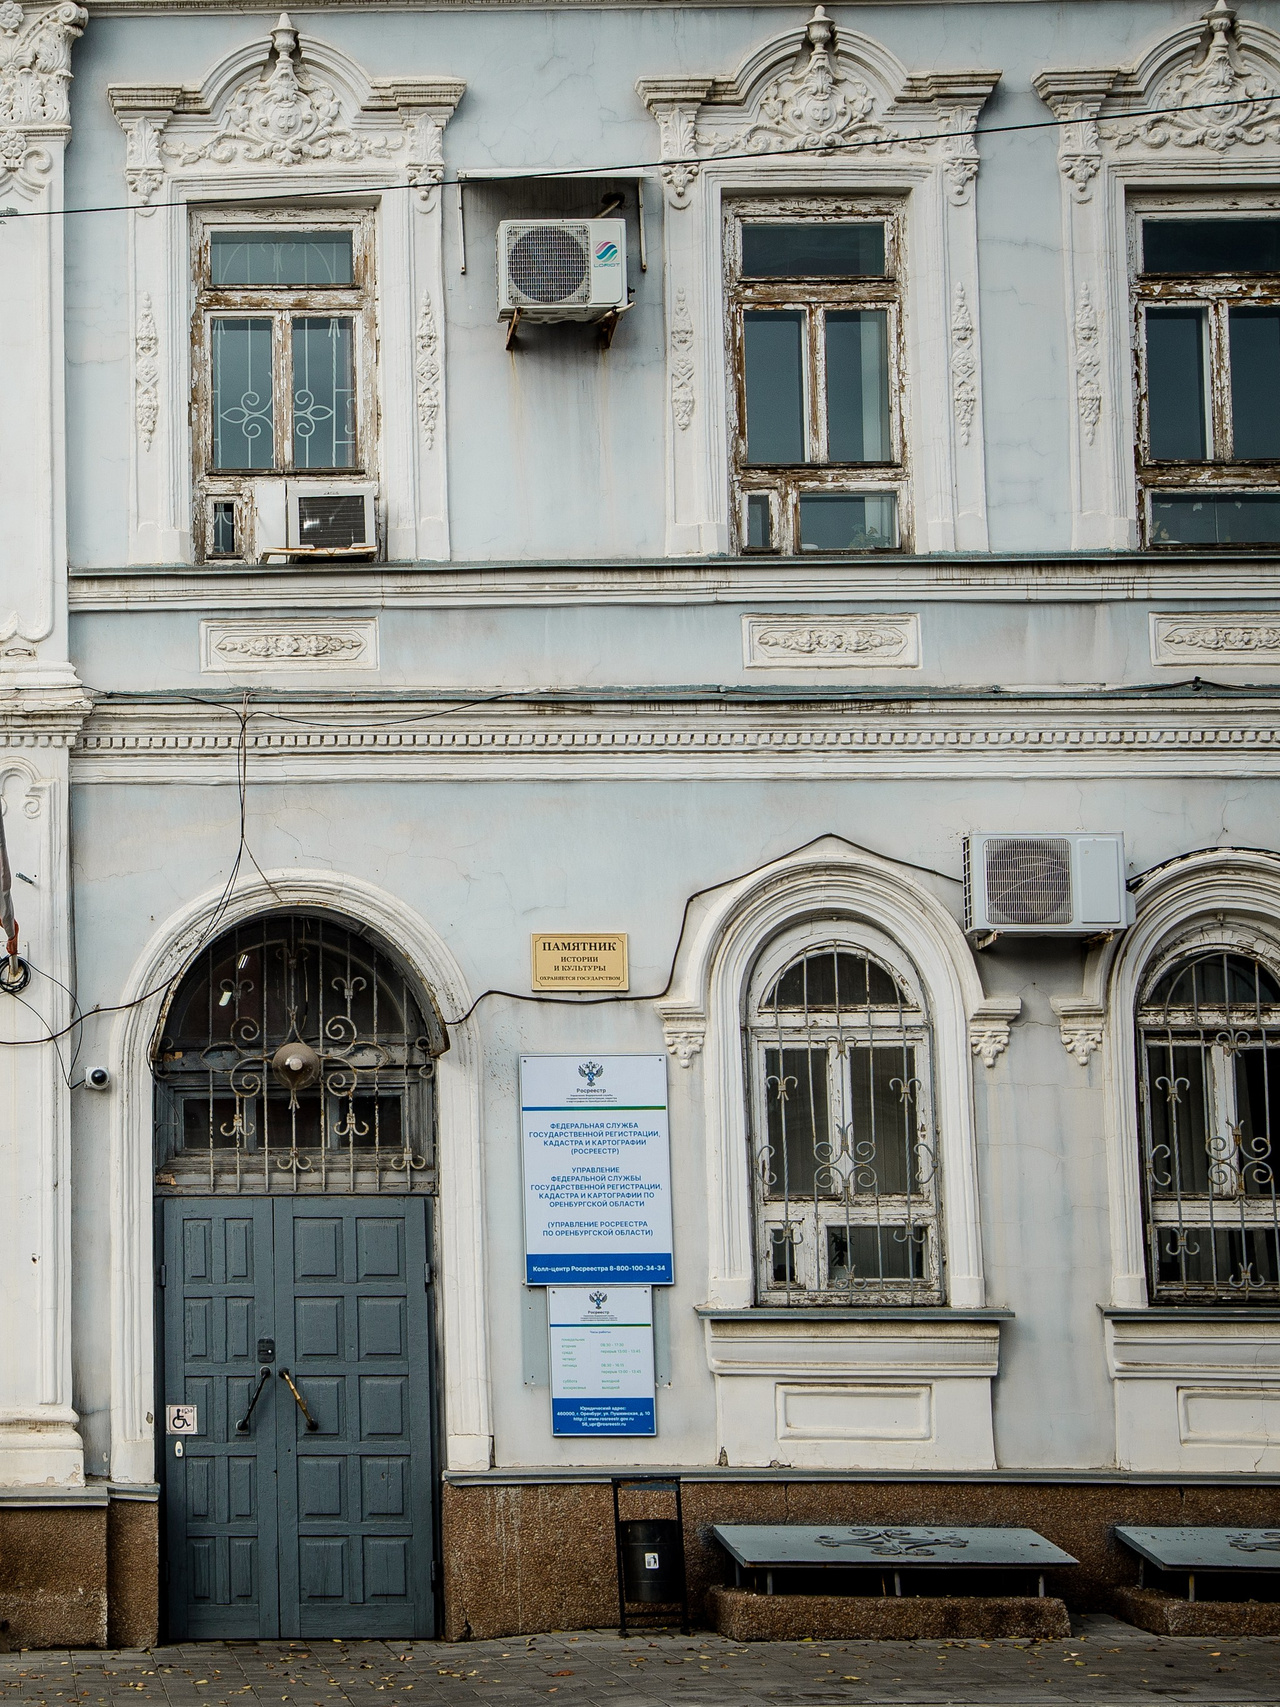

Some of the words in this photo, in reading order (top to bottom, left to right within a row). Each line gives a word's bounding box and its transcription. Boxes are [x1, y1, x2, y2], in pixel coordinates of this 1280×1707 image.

[542, 942, 616, 951] ПАМЯТНИК
[529, 1130, 604, 1138] ГОСУДАРСТВЕННОЙ
[551, 1174, 606, 1182] ФЕДЕРАЛЬНОЙ
[531, 1183, 605, 1191] ГОСУДАРСТВЕННОЙ
[607, 1183, 662, 1191] РЕГИСТРАЦИИ,
[615, 1229, 653, 1237] ОБЛАСТИ)
